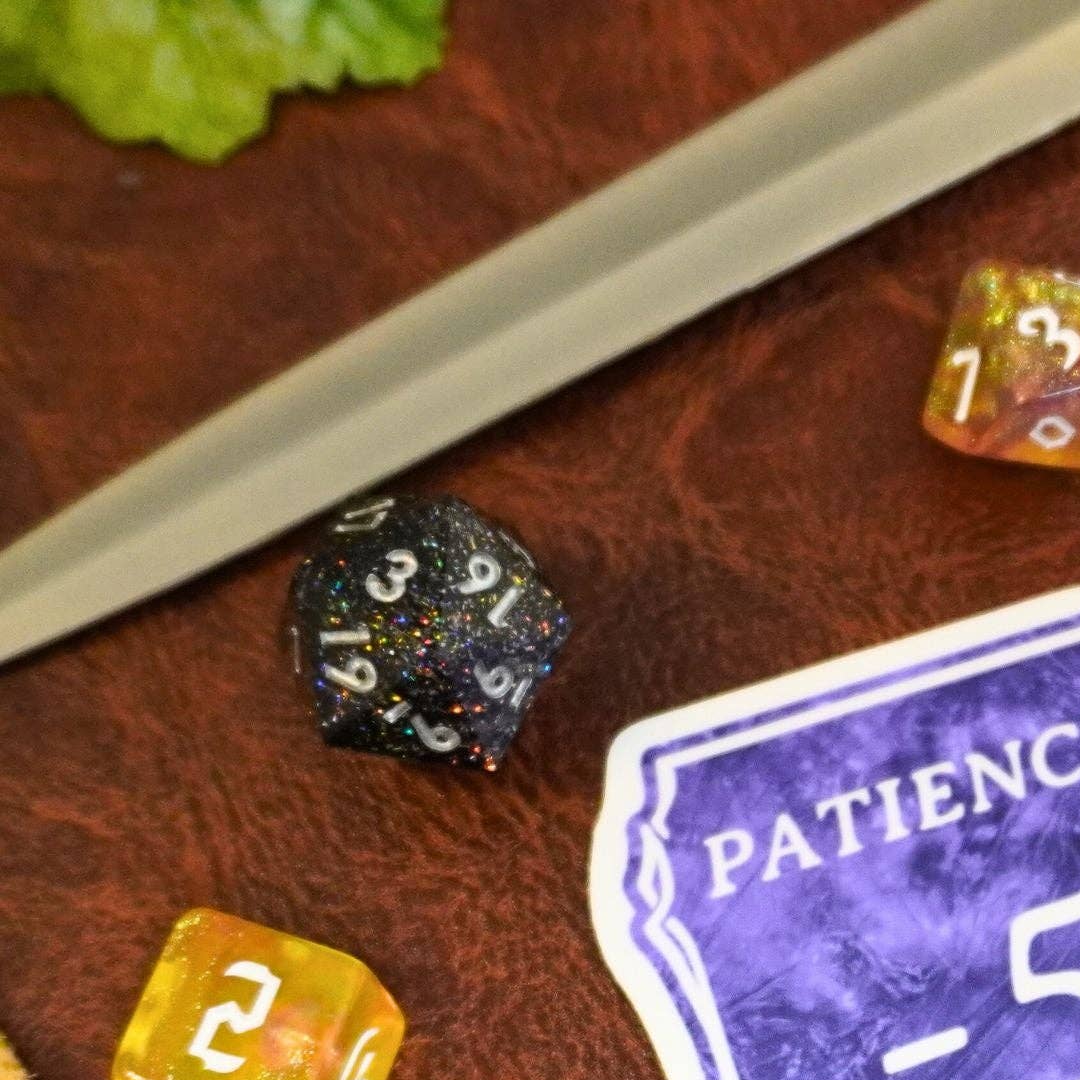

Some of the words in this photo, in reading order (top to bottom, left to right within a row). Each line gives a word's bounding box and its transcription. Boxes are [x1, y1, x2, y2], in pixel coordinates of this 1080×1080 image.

[1029, 416, 1077, 449] 0
[366, 549, 418, 602] 3
[188, 960, 282, 1074] 2
